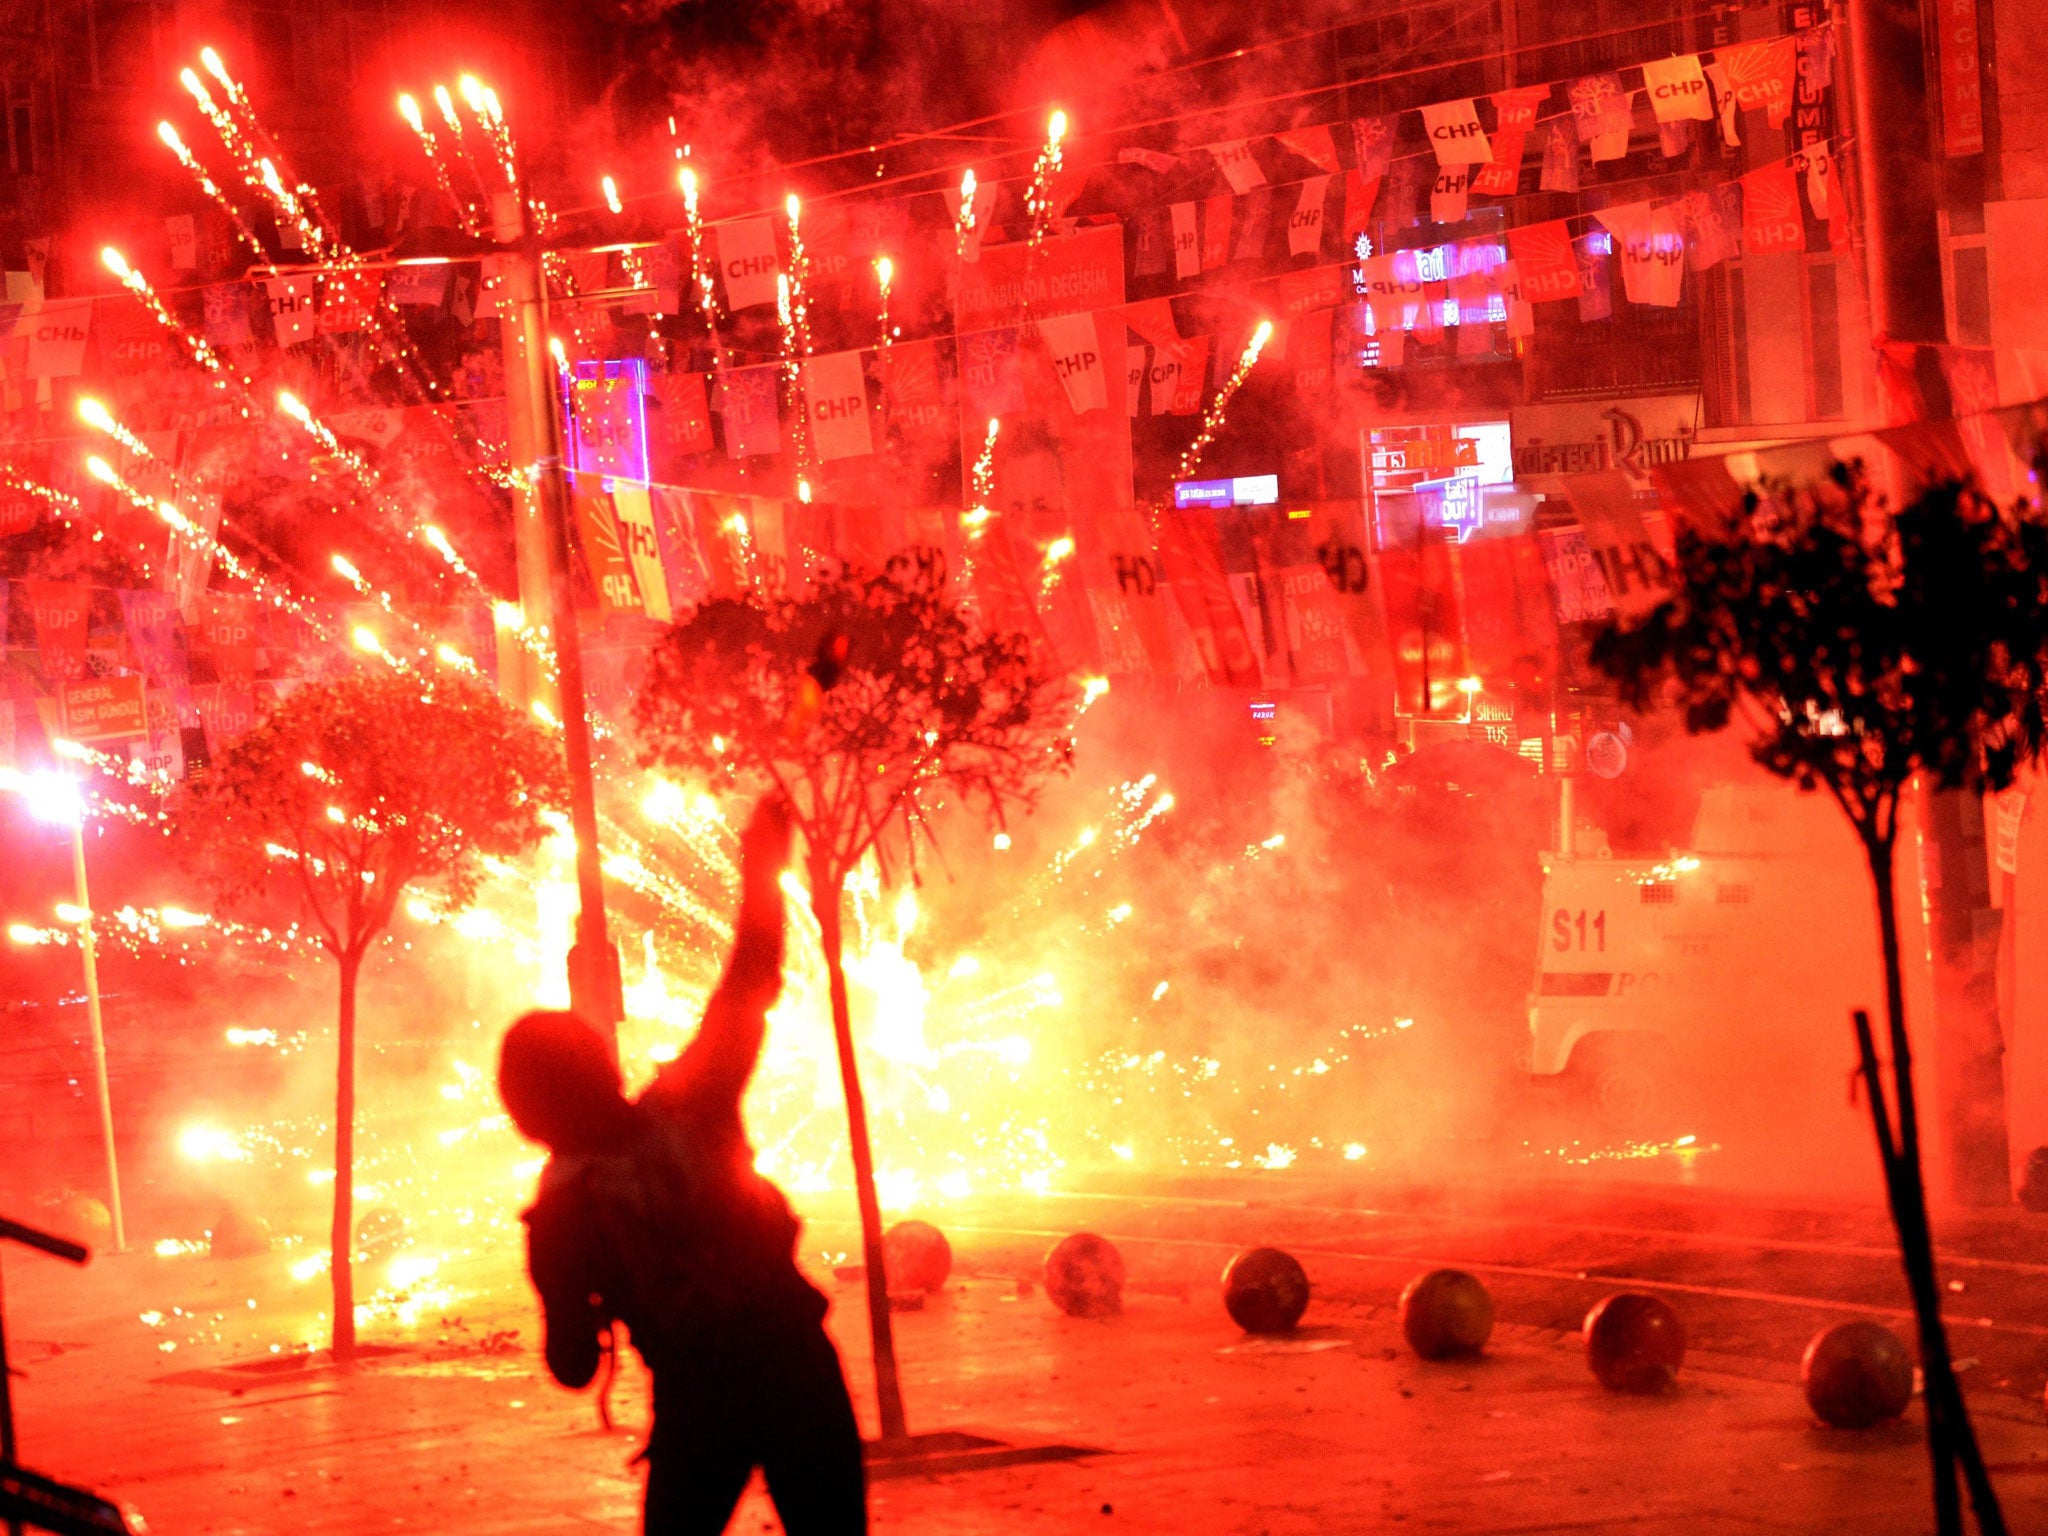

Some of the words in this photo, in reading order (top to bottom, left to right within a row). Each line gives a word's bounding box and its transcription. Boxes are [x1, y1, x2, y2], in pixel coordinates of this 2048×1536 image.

[1655, 80, 1704, 99] CHP
[1738, 78, 1783, 102] CHP
[1500, 107, 1532, 123] HP
[1433, 122, 1480, 139] CHP
[1434, 174, 1465, 194] CHP
[1474, 170, 1513, 188] CHP
[1291, 209, 1321, 229] CHP
[728, 255, 776, 279] CHP
[814, 396, 862, 421] CHP
[0, 503, 27, 526] HP
[1548, 552, 1593, 581] HDP
[35, 607, 79, 630] HDP
[207, 710, 249, 733] HDP
[1485, 725, 1508, 747] TUŞ
[1553, 908, 1606, 952] S11
